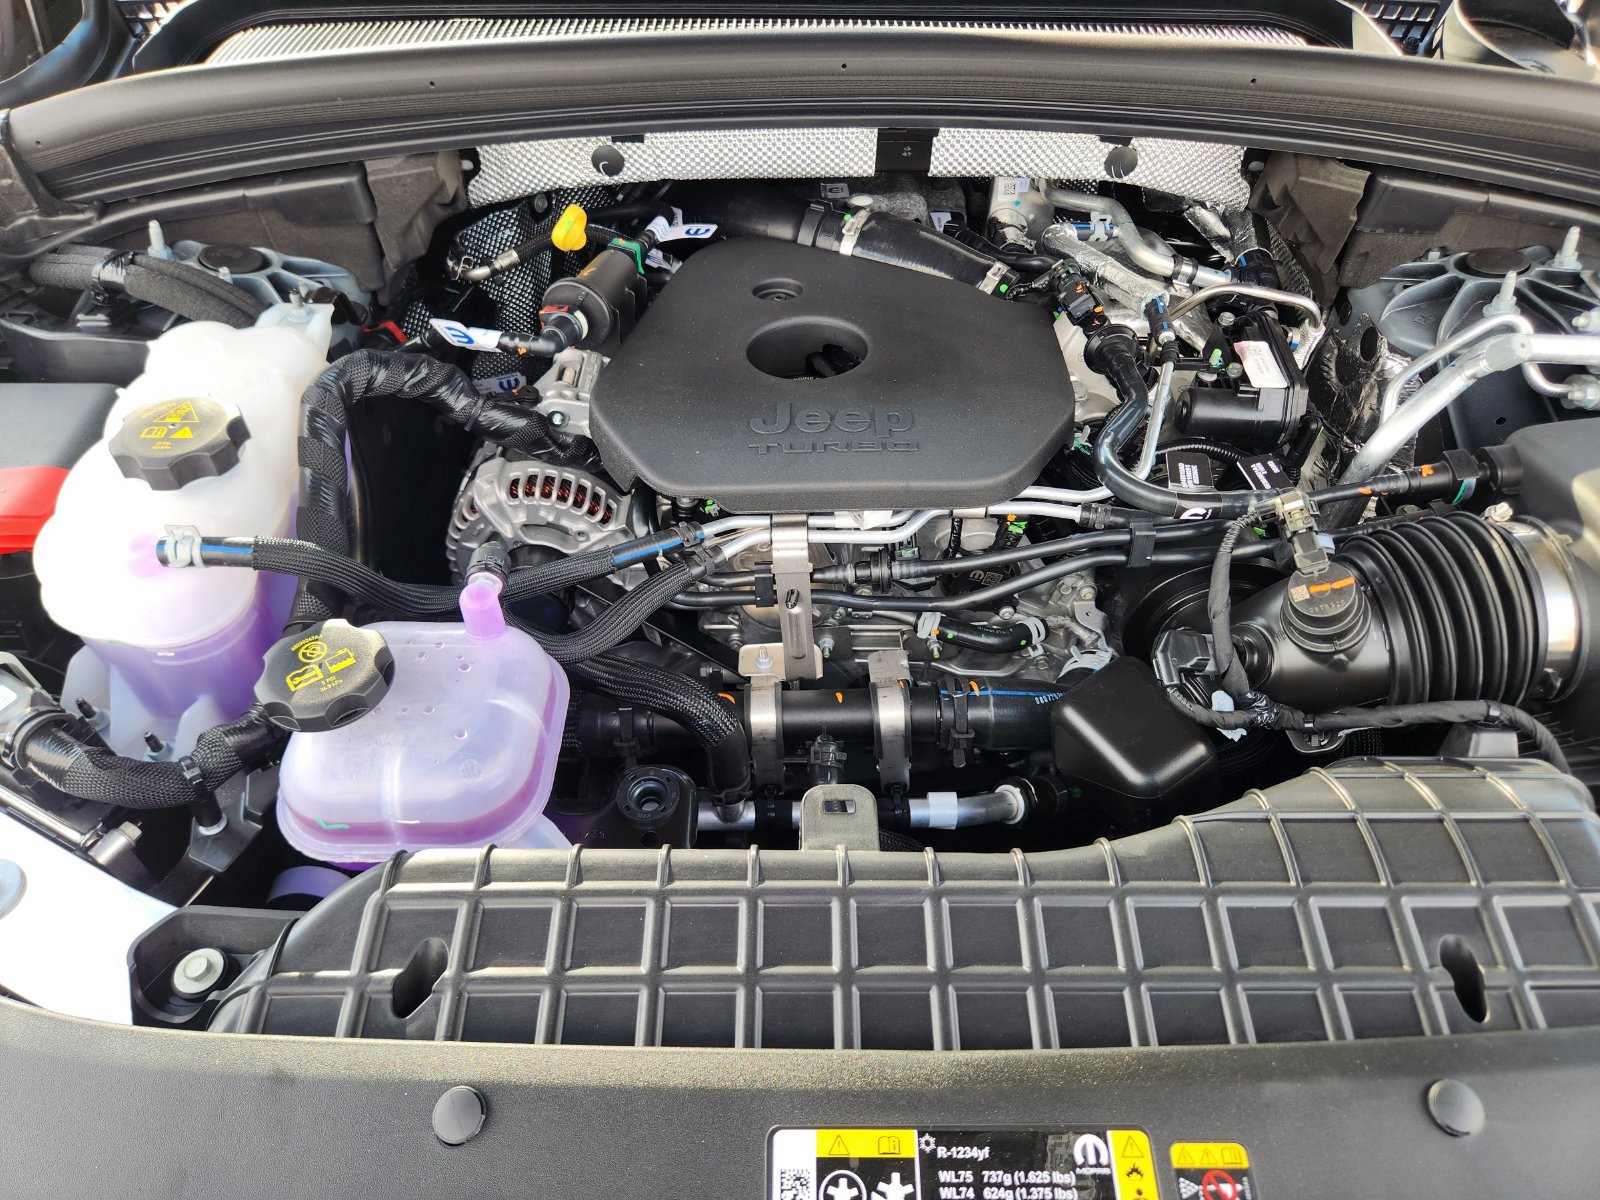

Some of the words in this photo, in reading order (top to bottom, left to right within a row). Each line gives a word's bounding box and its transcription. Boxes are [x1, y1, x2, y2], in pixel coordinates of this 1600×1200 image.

[749, 401, 914, 438] Jeep
[748, 440, 919, 455] TURBO
[936, 1146, 991, 1161] R-1234yf
[937, 1170, 974, 1183] WL75
[981, 1170, 1012, 1186] 737g
[1013, 1170, 1051, 1186] (1.625
[1051, 1170, 1077, 1186] lbs)
[938, 1187, 975, 1200] WL74
[983, 1186, 1014, 1200] 624g
[1014, 1186, 1052, 1200] (1.375
[1052, 1186, 1079, 1200] lbs)
